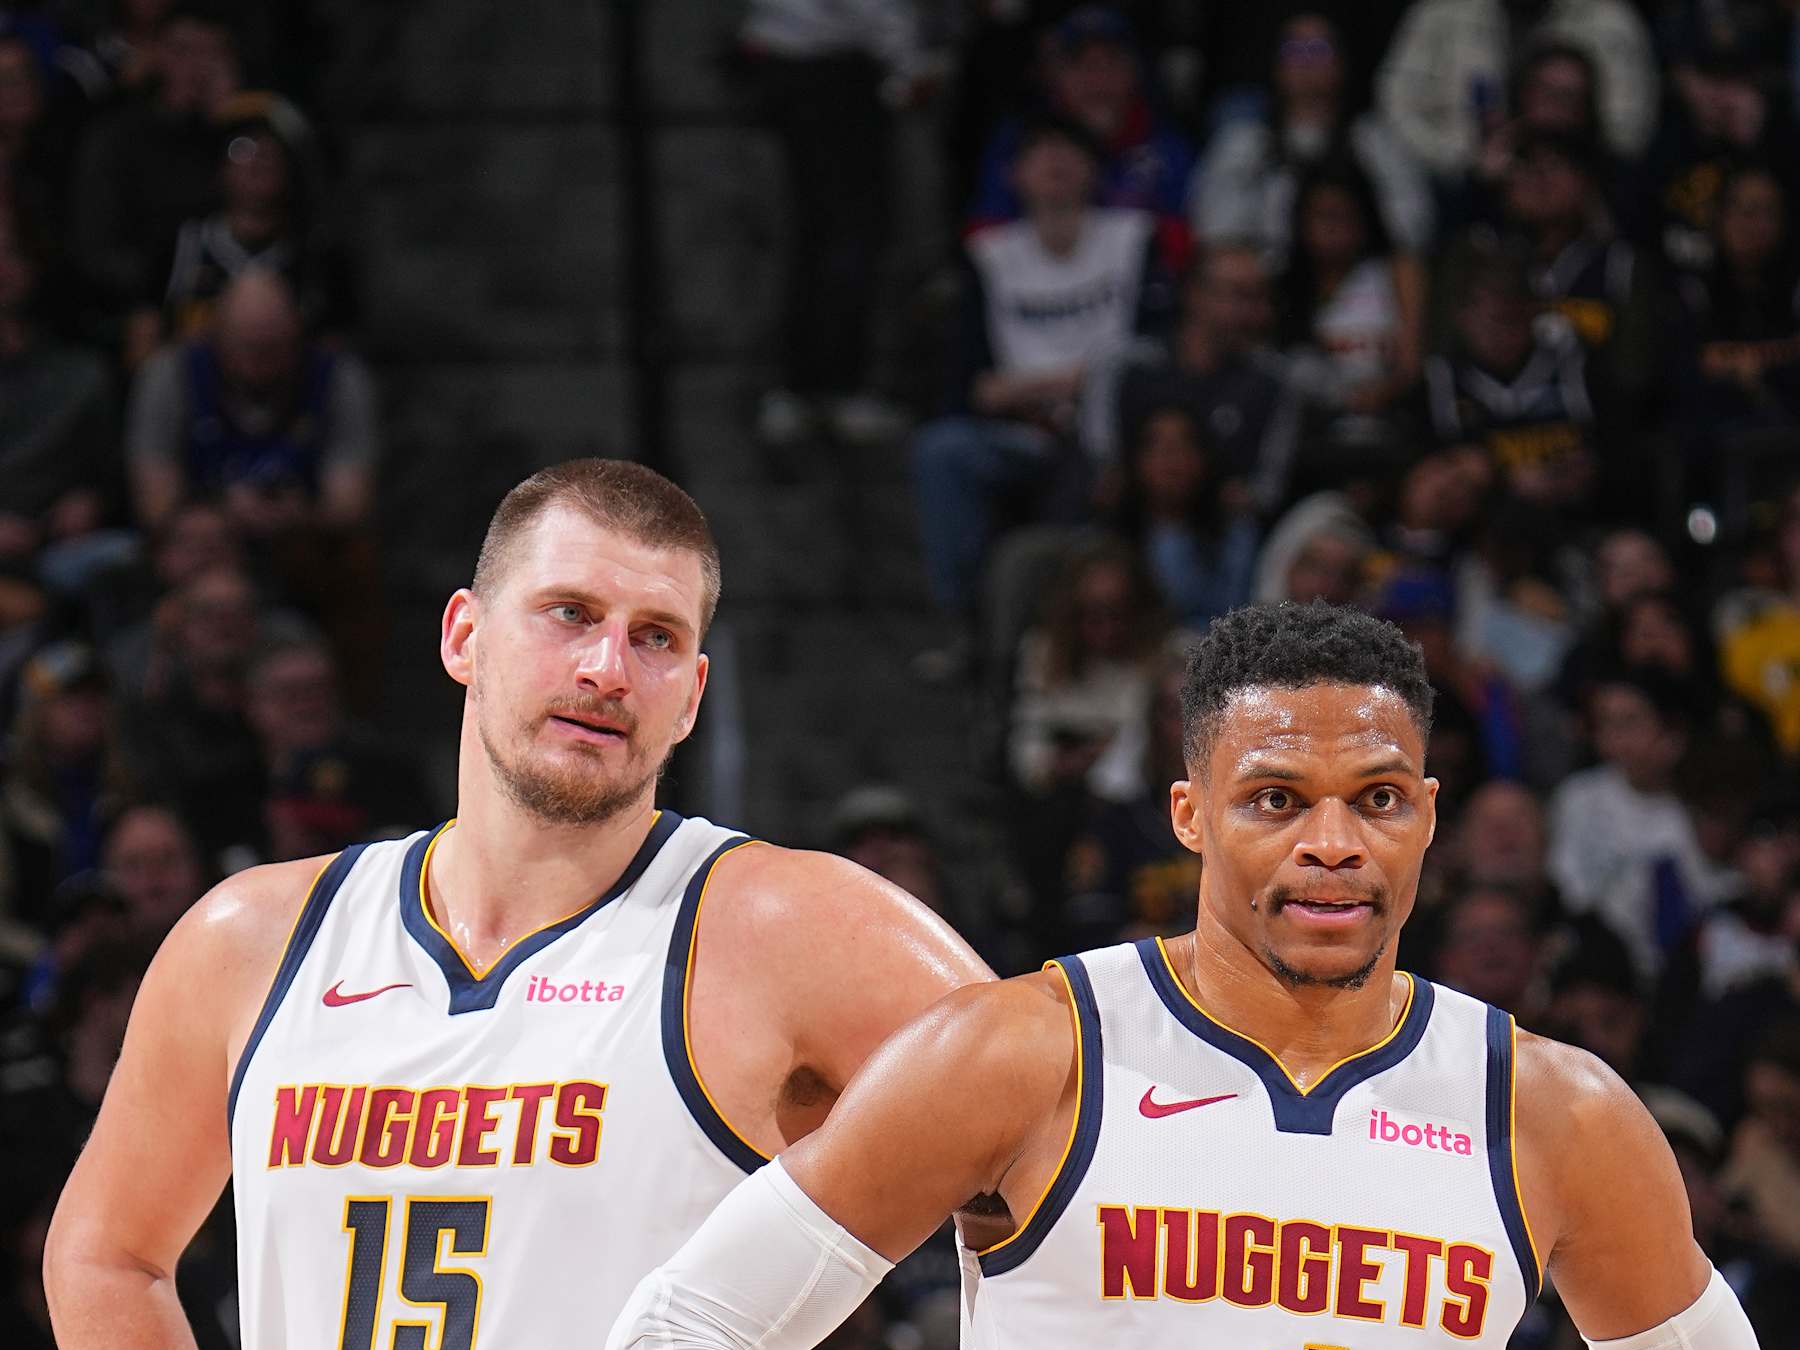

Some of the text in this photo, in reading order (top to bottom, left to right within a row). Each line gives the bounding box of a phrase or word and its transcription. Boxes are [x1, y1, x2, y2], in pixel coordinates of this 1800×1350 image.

[526, 975, 625, 1003] ibotta
[265, 1079, 610, 1171] NUGGETS
[1369, 1108, 1472, 1155] ibotta
[1096, 1203, 1495, 1340] NUGGETS
